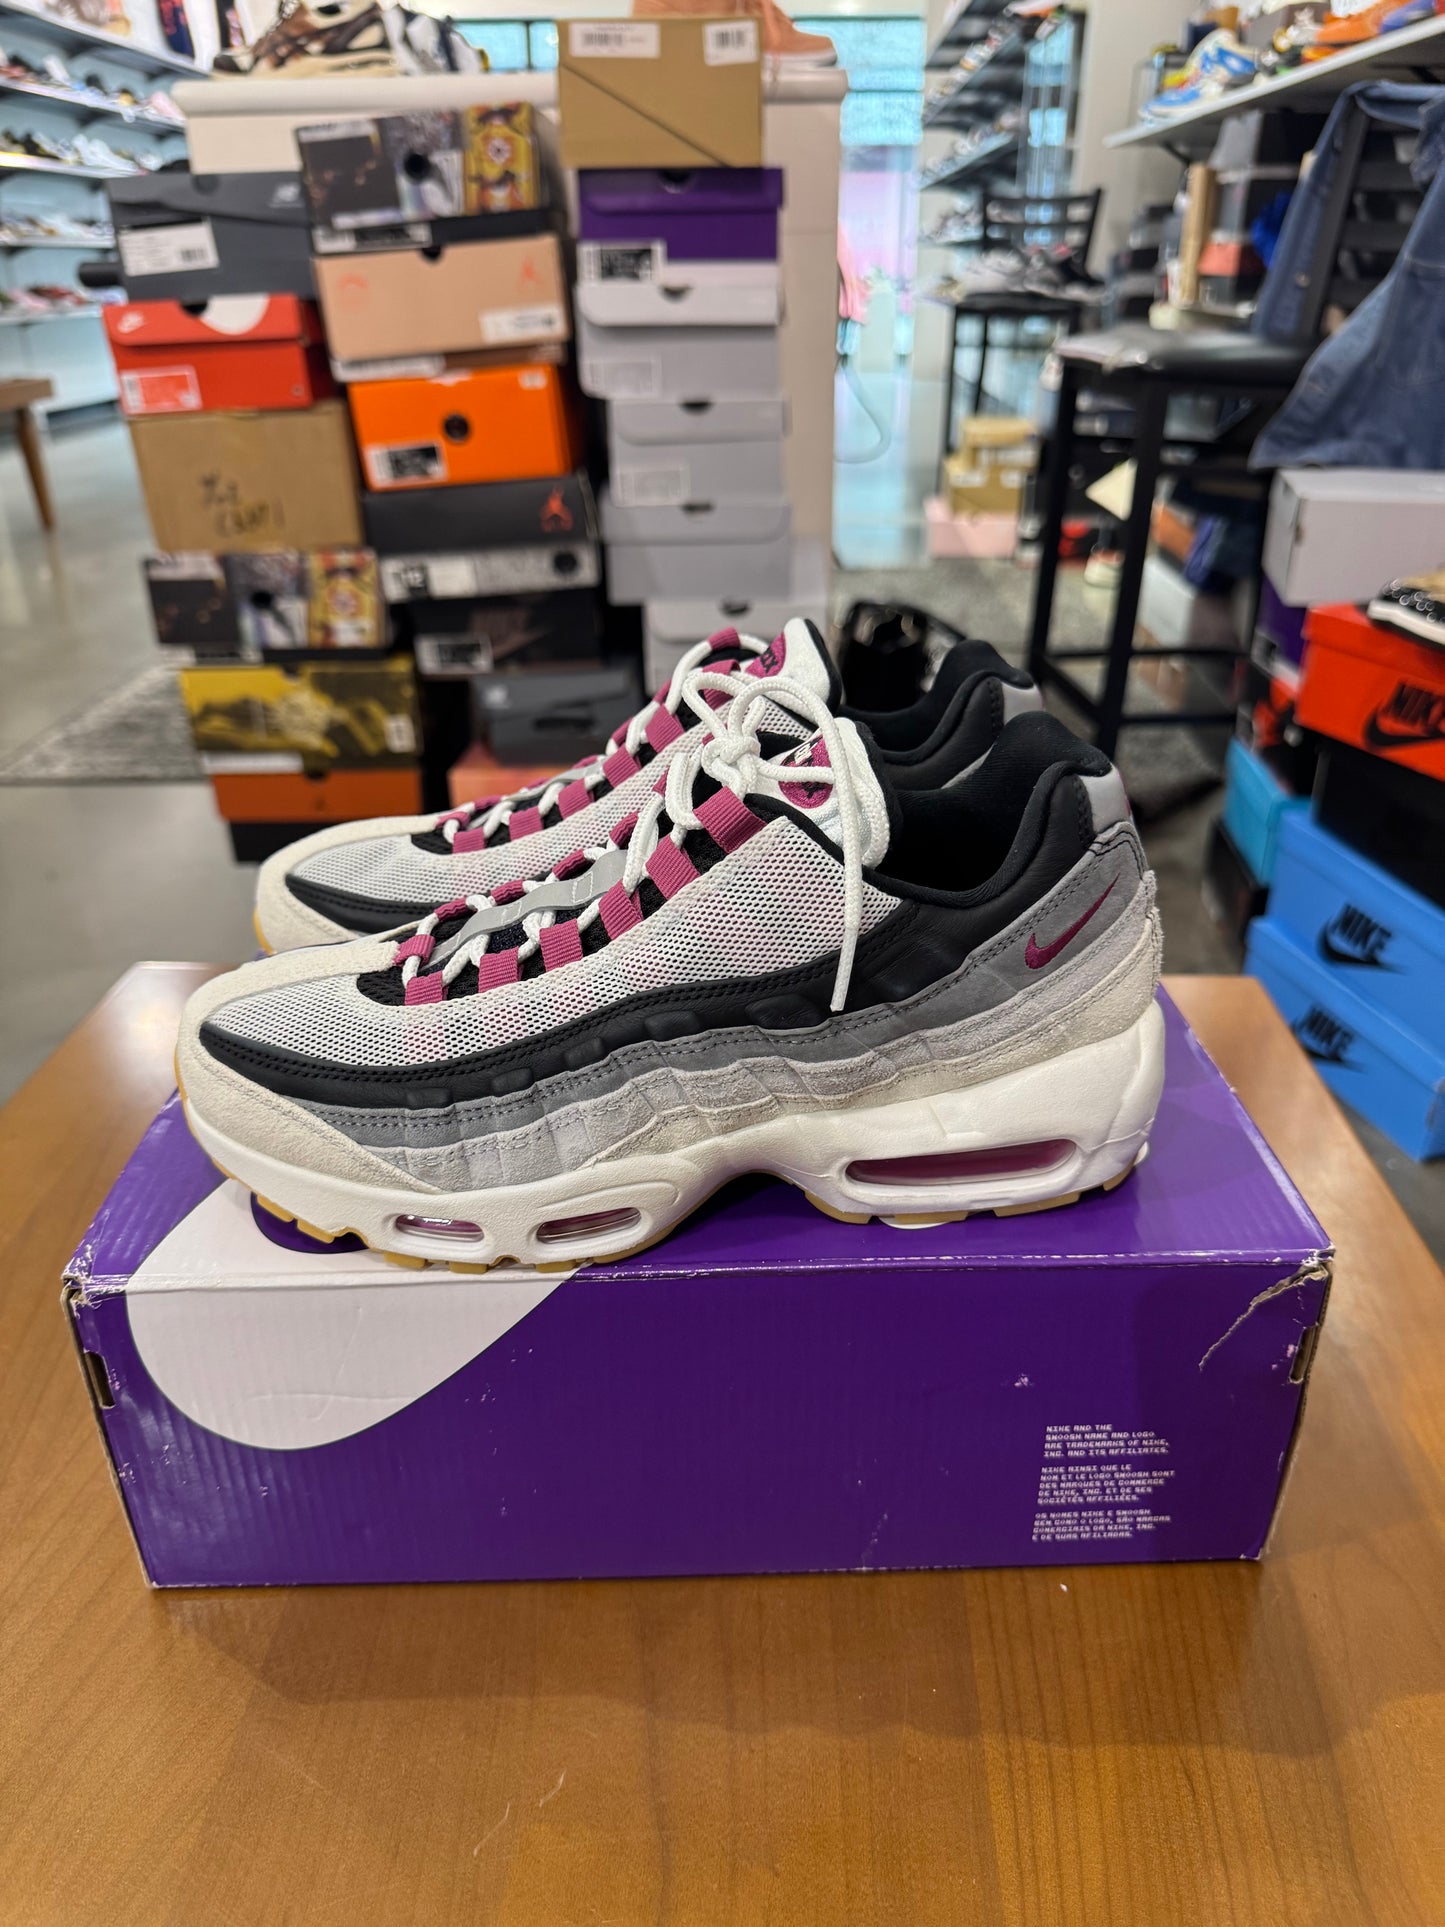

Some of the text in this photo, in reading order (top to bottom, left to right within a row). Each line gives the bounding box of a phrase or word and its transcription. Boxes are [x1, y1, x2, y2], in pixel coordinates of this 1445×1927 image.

[1329, 903, 1392, 962] NIKE
[1300, 1006, 1355, 1063] NIKE
[1066, 1440, 1124, 1448] TRADEMARKS
[1108, 1447, 1169, 1455] AFFILIATES.
[1118, 1478, 1165, 1486] COMMERCE
[1116, 1508, 1151, 1516] SWOOSH
